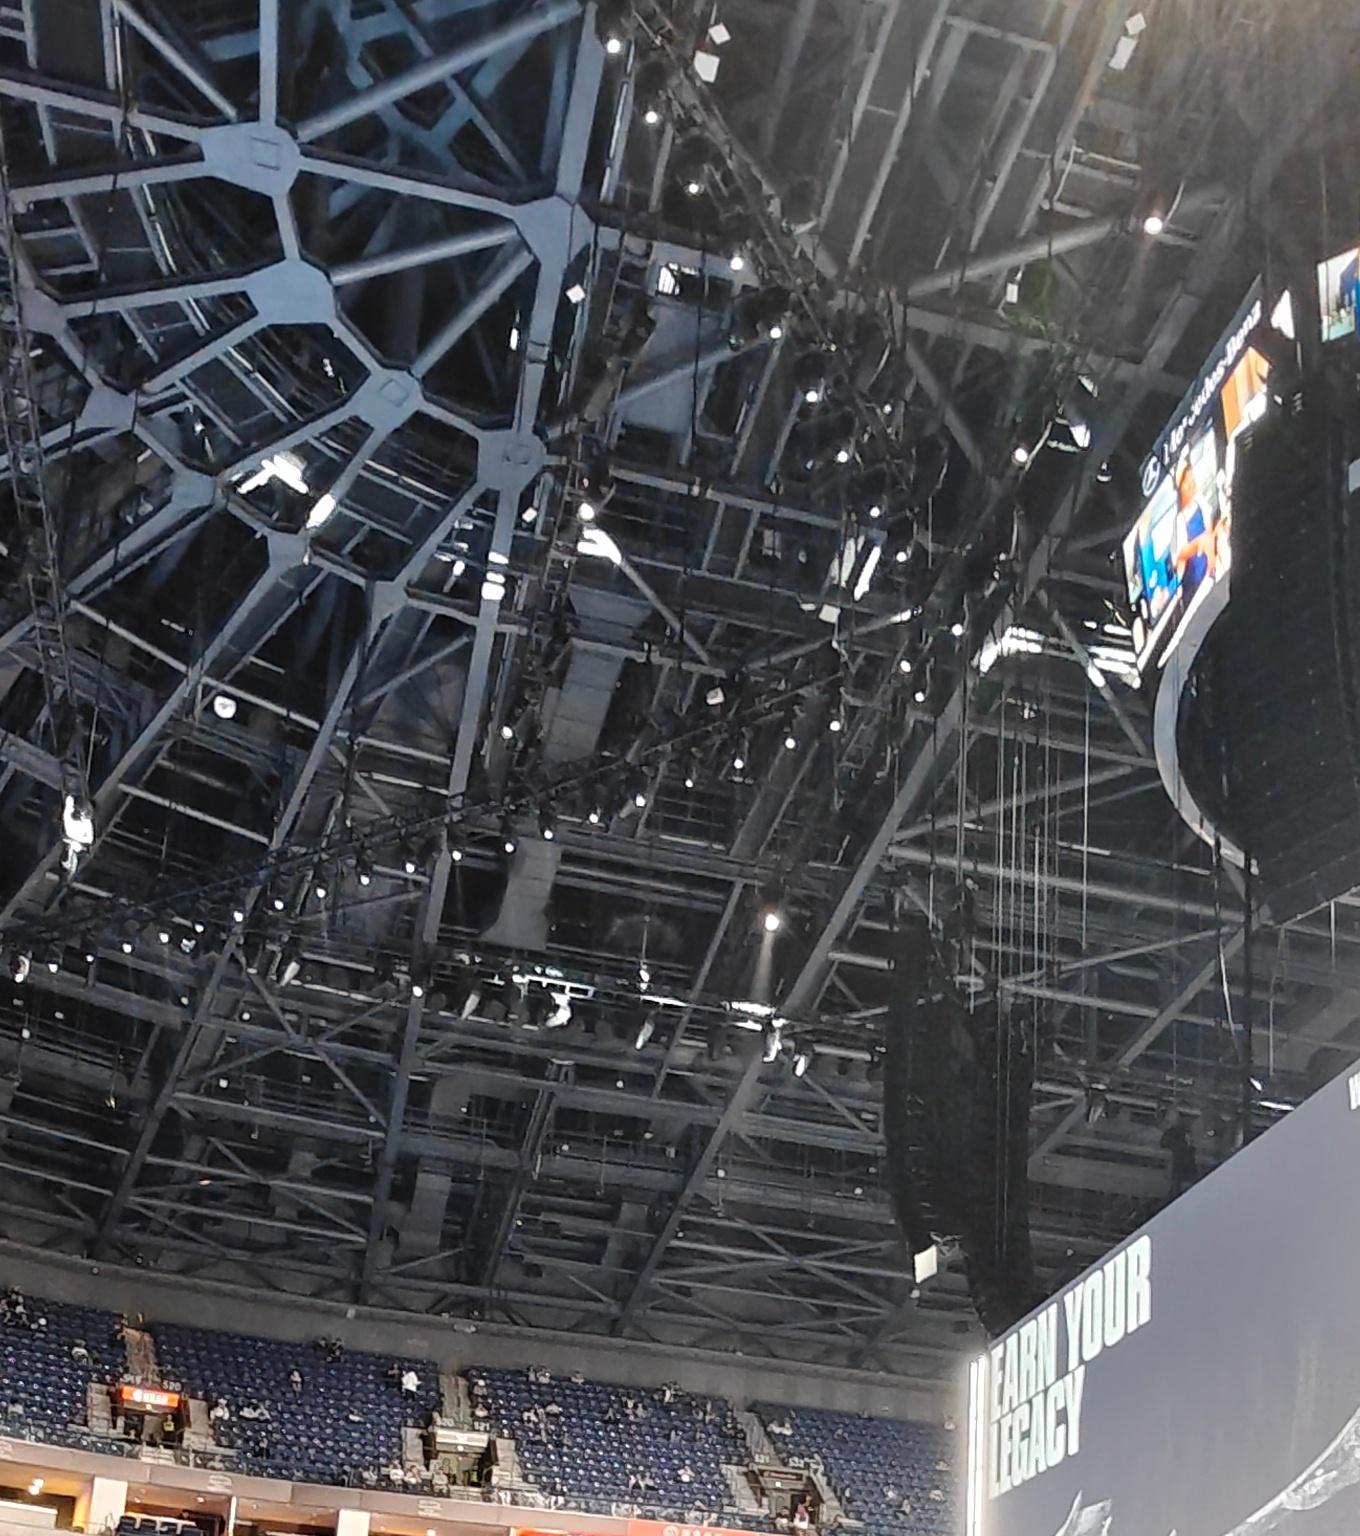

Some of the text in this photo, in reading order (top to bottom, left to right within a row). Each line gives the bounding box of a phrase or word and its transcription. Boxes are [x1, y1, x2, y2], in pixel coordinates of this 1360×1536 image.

[991, 1234, 1151, 1422] EARN YOUR
[991, 1365, 1085, 1499] LEGACY
